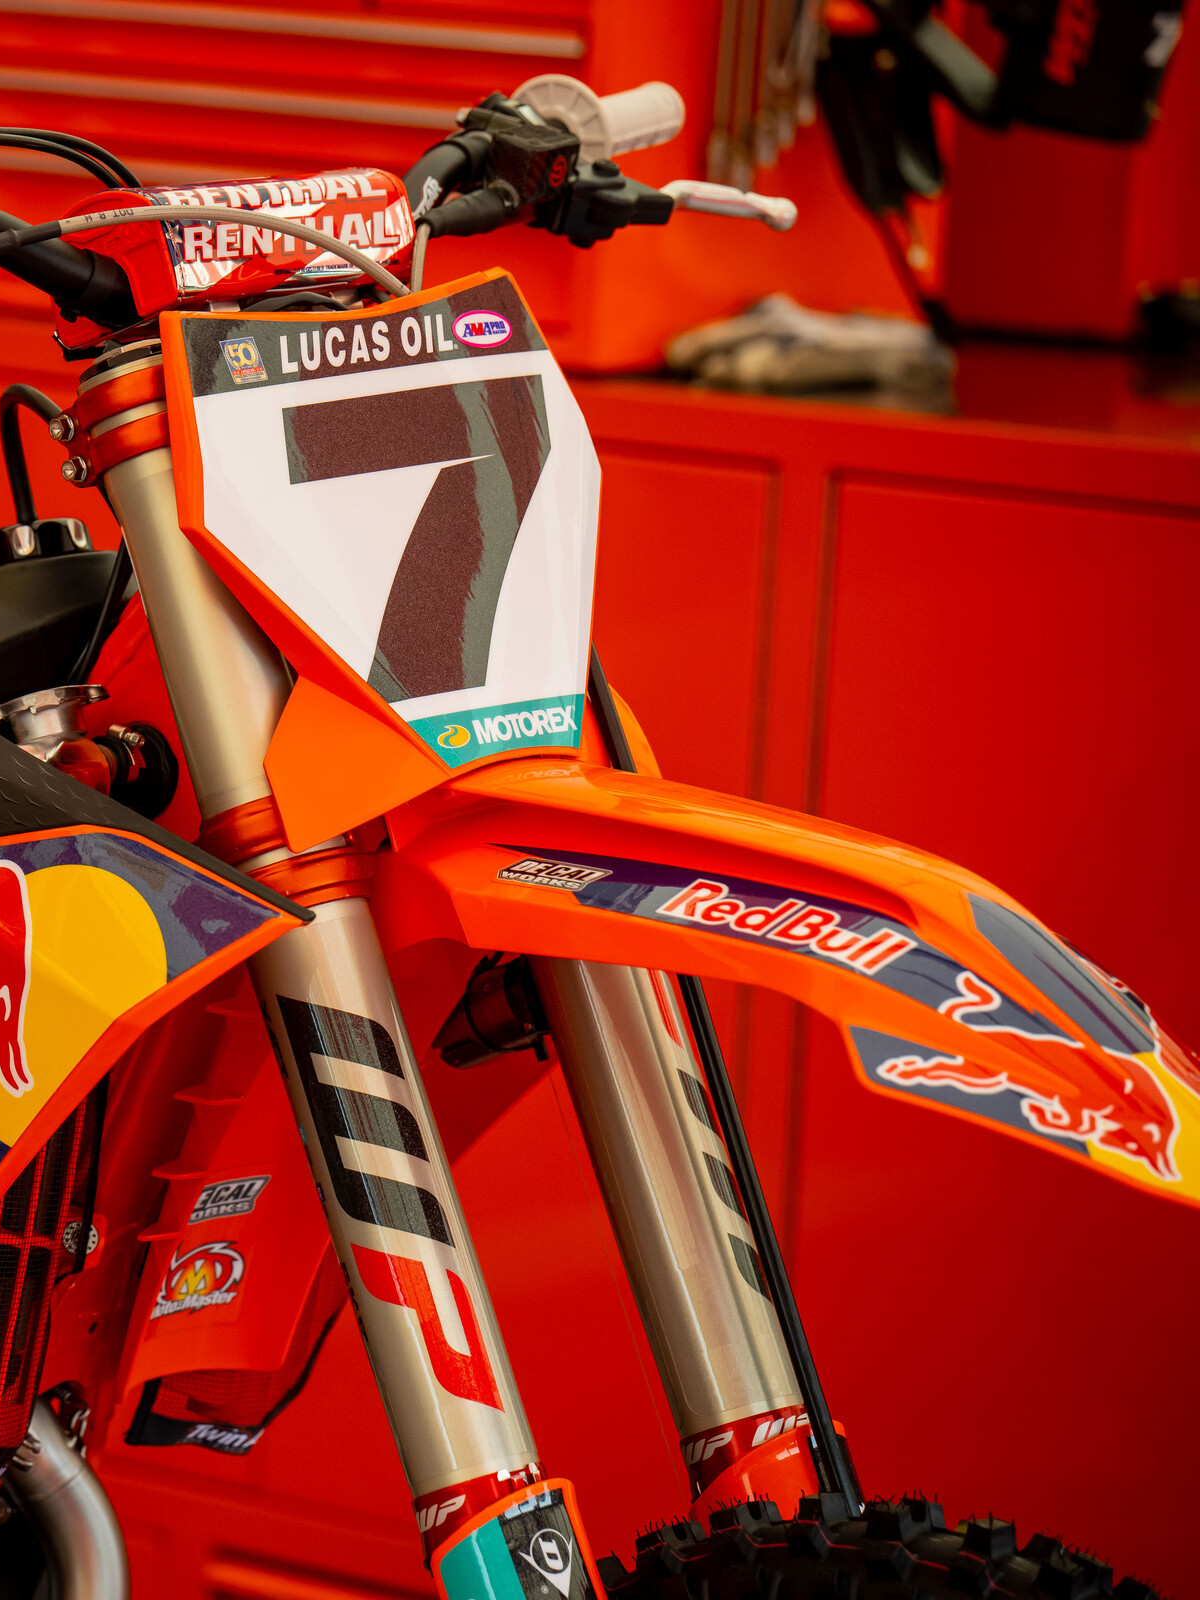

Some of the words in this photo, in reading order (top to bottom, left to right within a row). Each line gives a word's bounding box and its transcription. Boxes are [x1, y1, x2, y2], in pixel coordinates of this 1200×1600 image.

[163, 174, 388, 208] RENTHAL
[183, 210, 402, 262] RENTHAL
[462, 321, 492, 338] AMA
[490, 320, 506, 330] PRO
[227, 343, 256, 367] 50
[279, 319, 391, 375] LUCAS
[400, 313, 454, 357] OIL
[282, 374, 551, 704] 7
[471, 705, 578, 745] MOTOREX
[501, 870, 583, 890] WORKS
[510, 859, 597, 882] DECAL
[657, 879, 805, 937] Red
[773, 905, 918, 975] Bull
[195, 1182, 256, 1209] ECAL
[189, 1203, 251, 1221] ORKS
[186, 1423, 249, 1448] Twin
